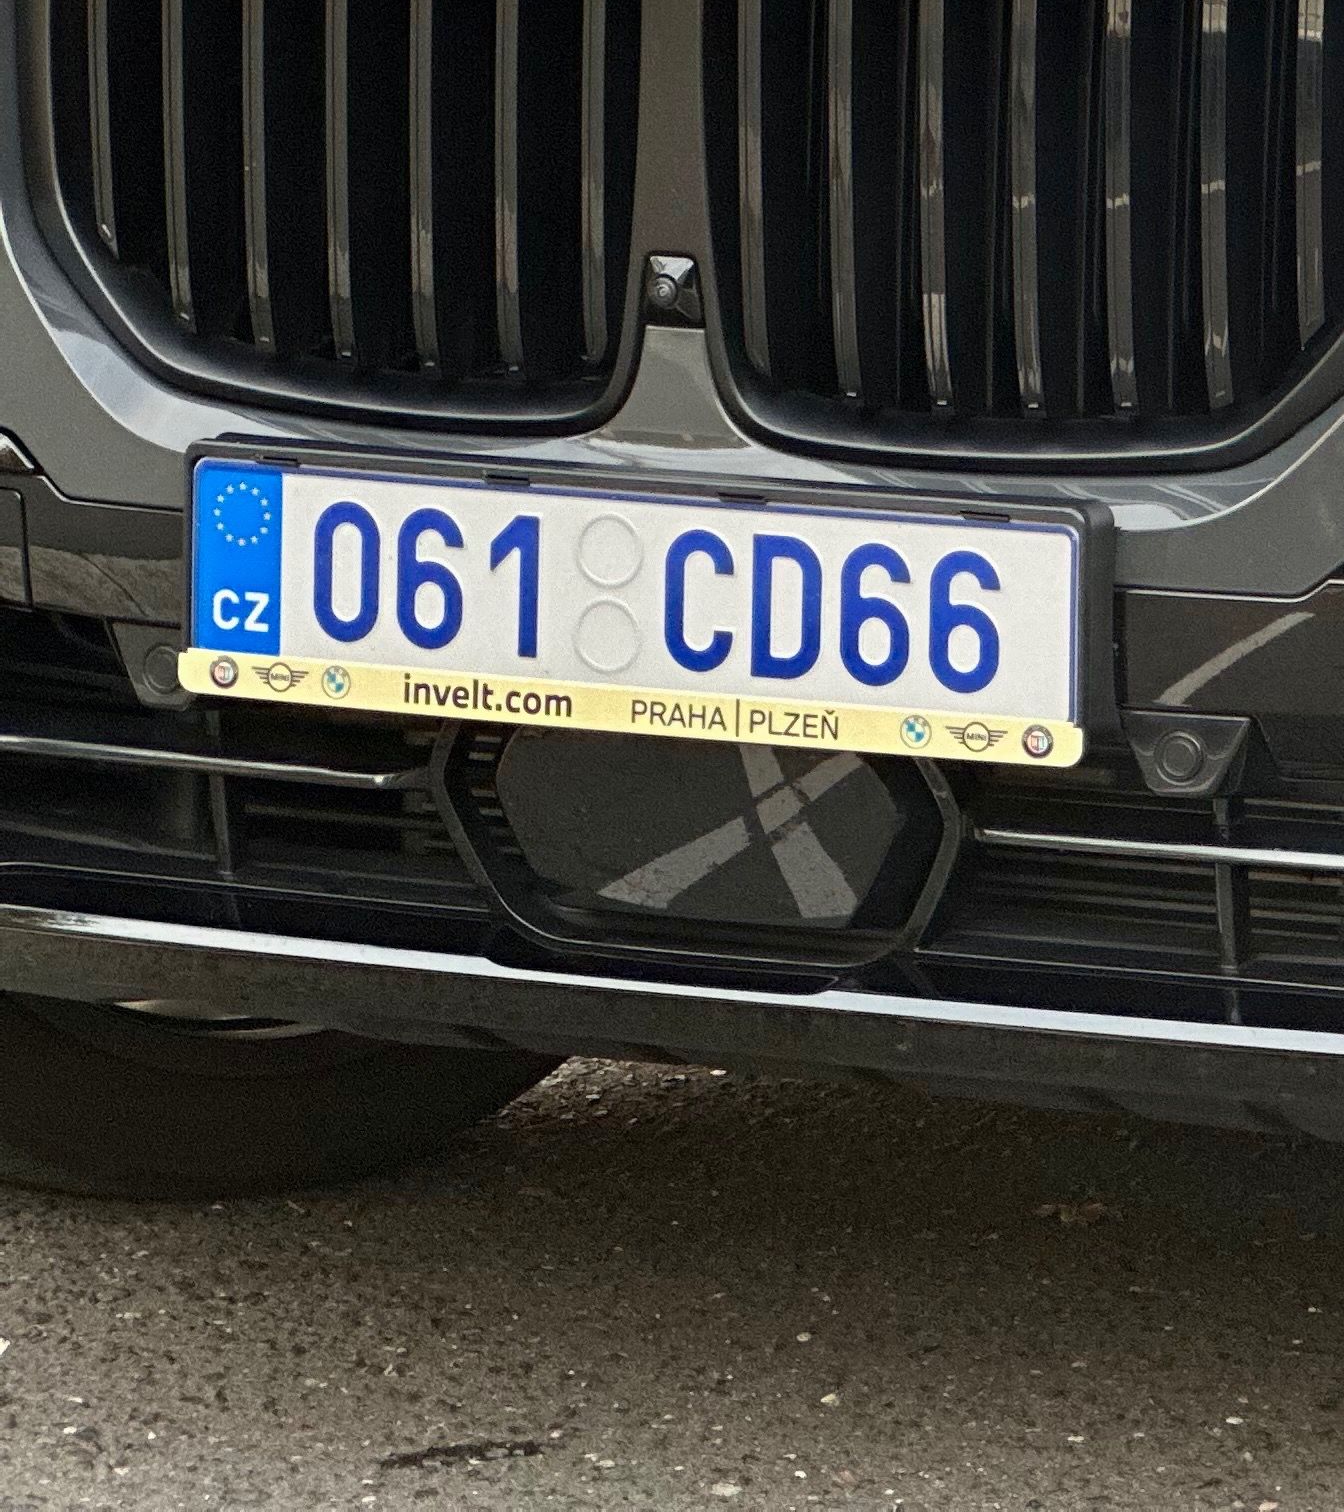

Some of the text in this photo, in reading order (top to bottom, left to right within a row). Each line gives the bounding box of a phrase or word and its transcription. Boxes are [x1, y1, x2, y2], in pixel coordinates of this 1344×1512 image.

[212, 588, 270, 633] CZ
[312, 500, 1001, 694] 061 CD66
[403, 673, 573, 717] invelt.com
[630, 699, 840, 740] PRAHA PLZEŇ
